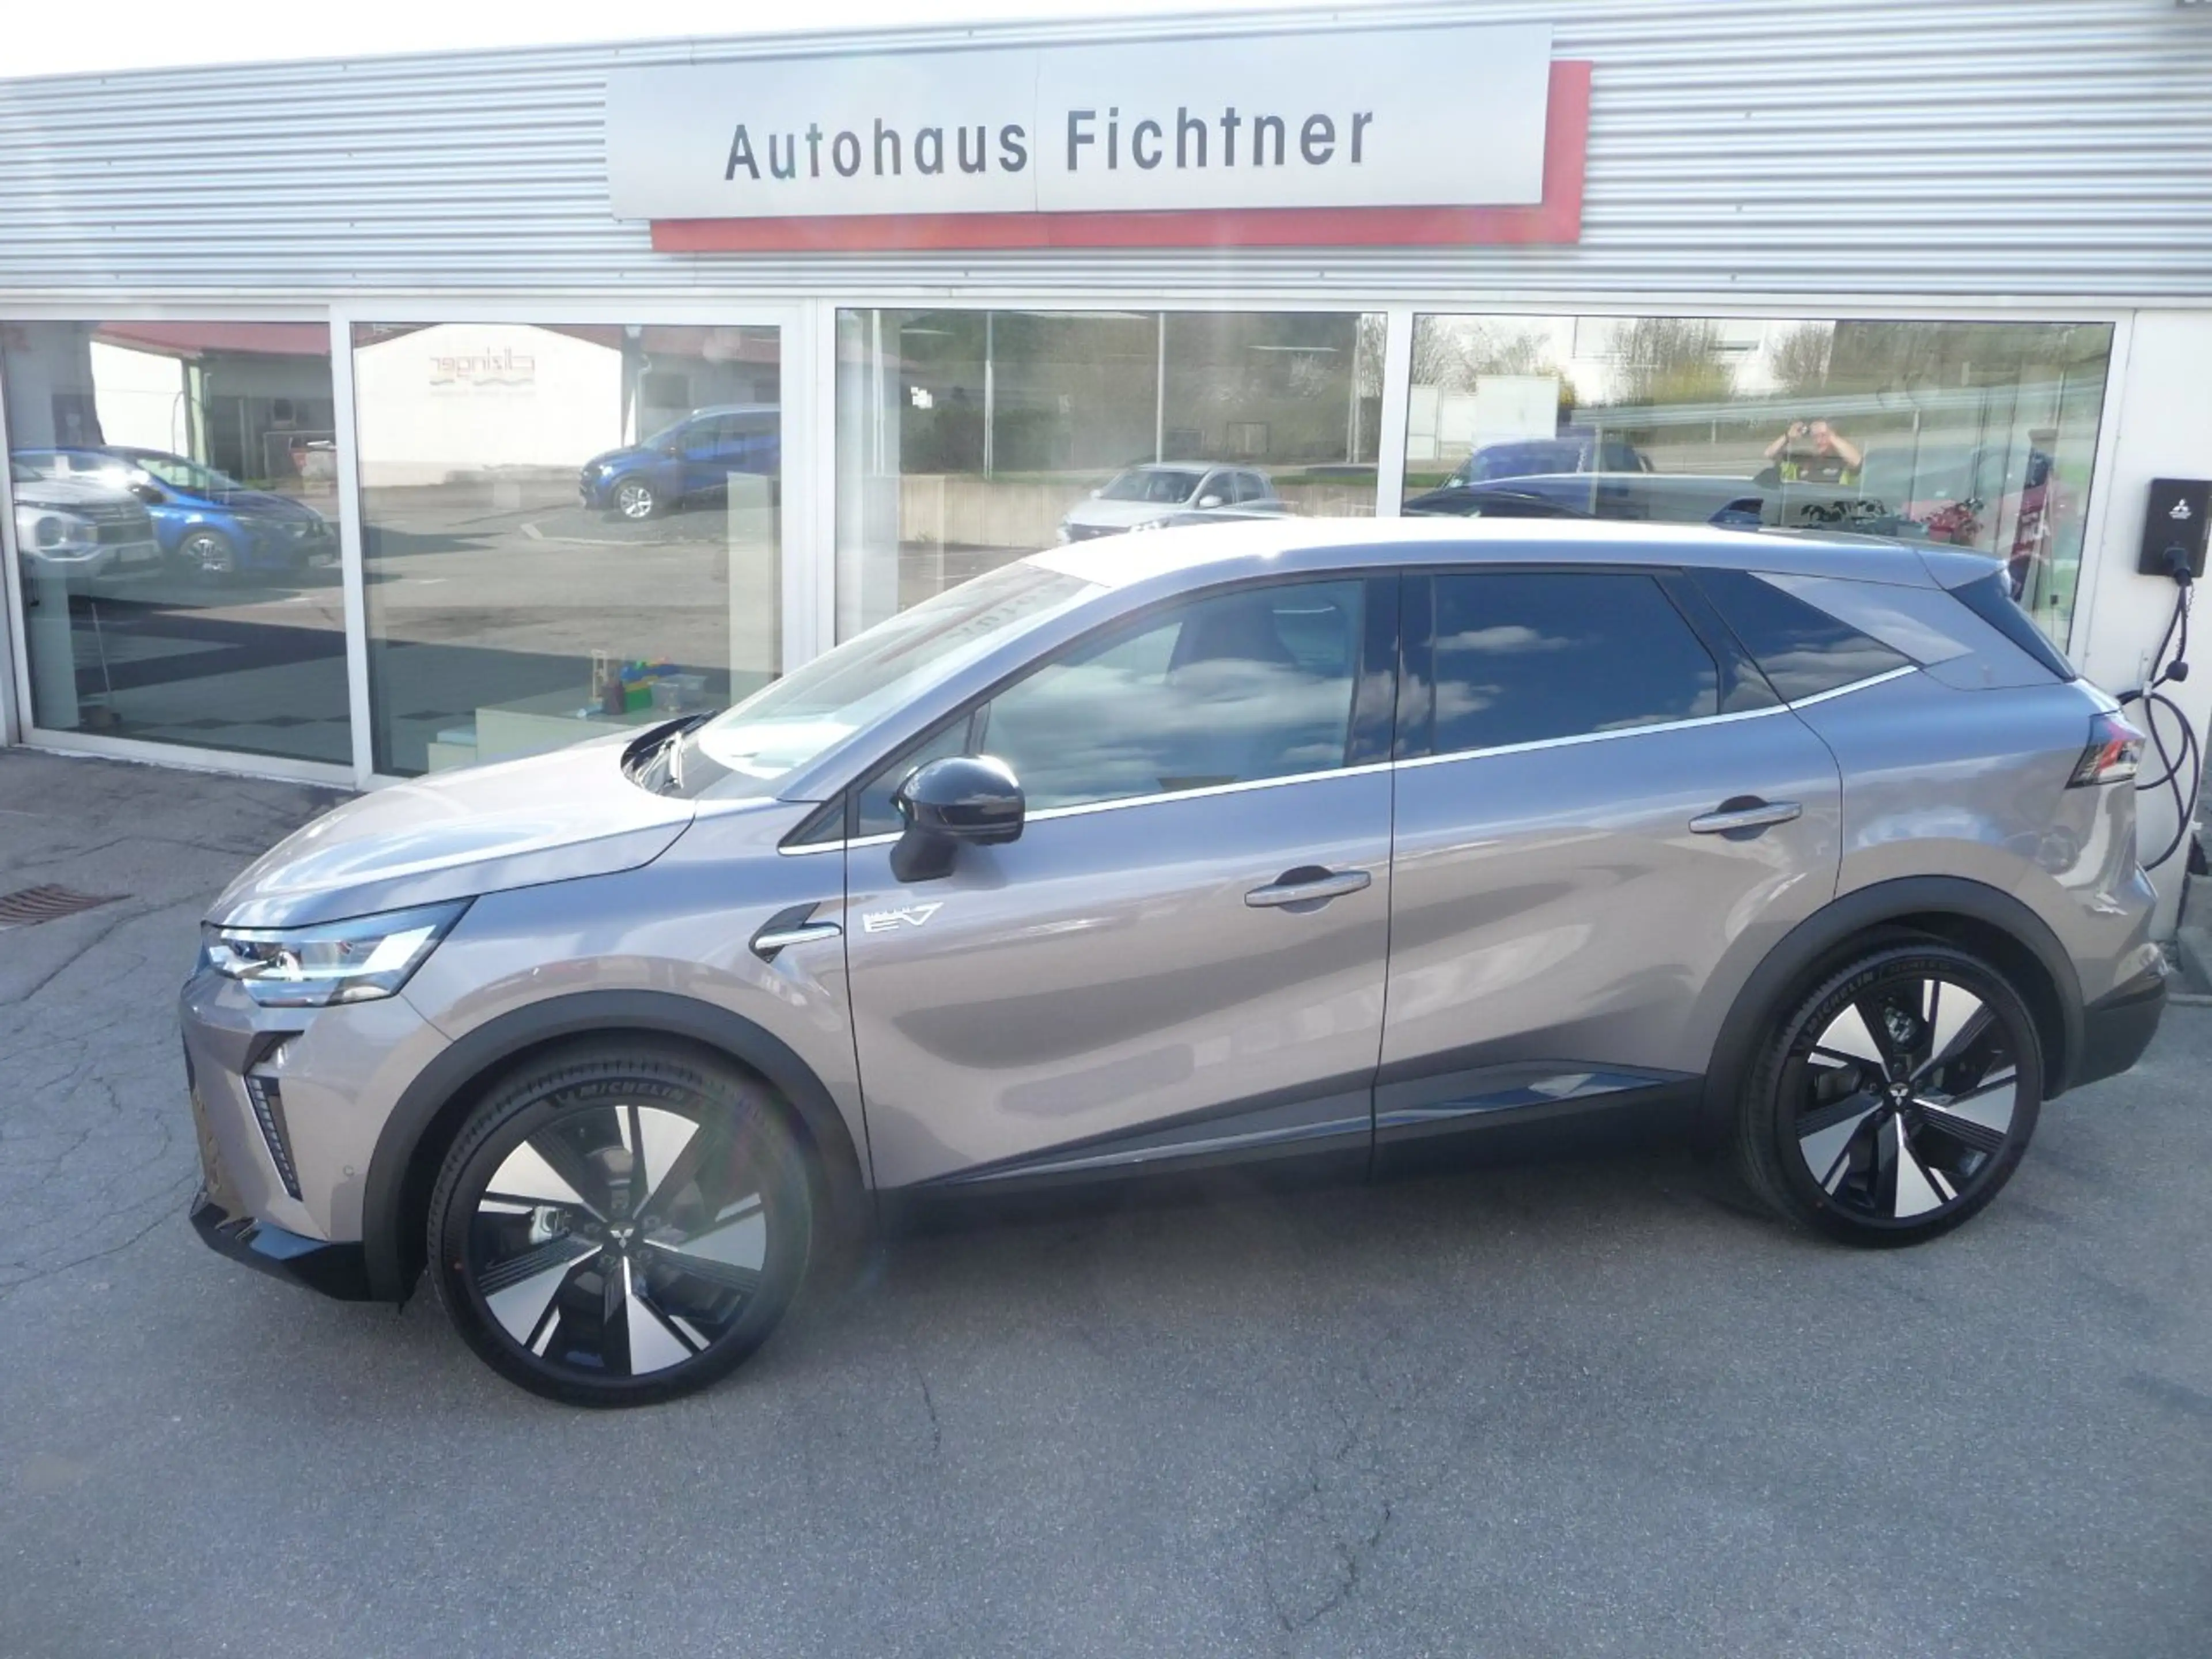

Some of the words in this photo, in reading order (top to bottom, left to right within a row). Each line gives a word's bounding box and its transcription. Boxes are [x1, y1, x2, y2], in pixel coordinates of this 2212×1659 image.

[725, 119, 1027, 180] Autohaus
[1067, 107, 1373, 171] Fichtner
[579, 1081, 684, 1101] MICHELIN
